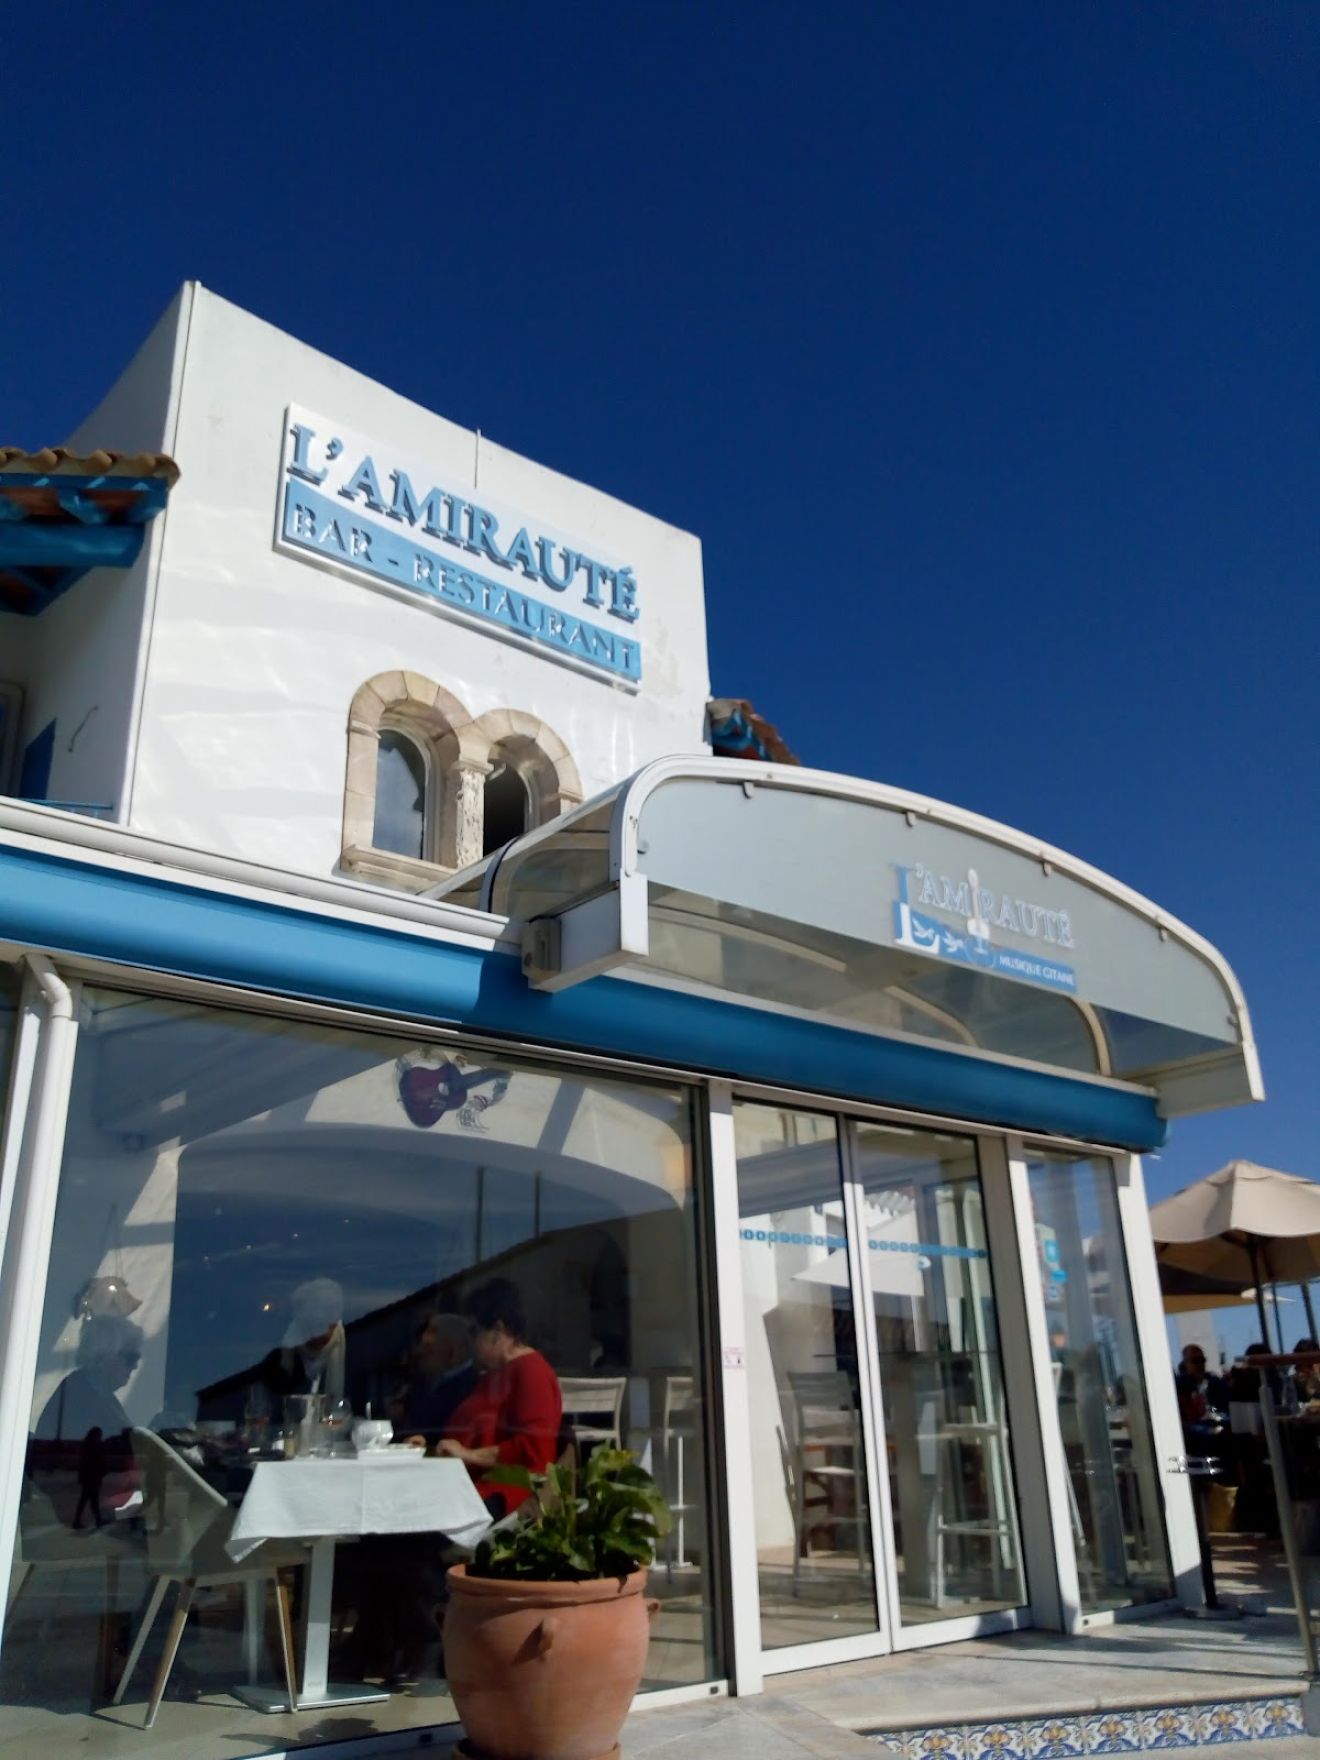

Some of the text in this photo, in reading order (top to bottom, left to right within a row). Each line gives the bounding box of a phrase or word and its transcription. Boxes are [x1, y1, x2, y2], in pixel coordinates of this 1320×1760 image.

[287, 423, 640, 624] L'AMIRAUTÉ
[293, 503, 374, 563] BAR
[413, 552, 635, 670] RESTAURANT
